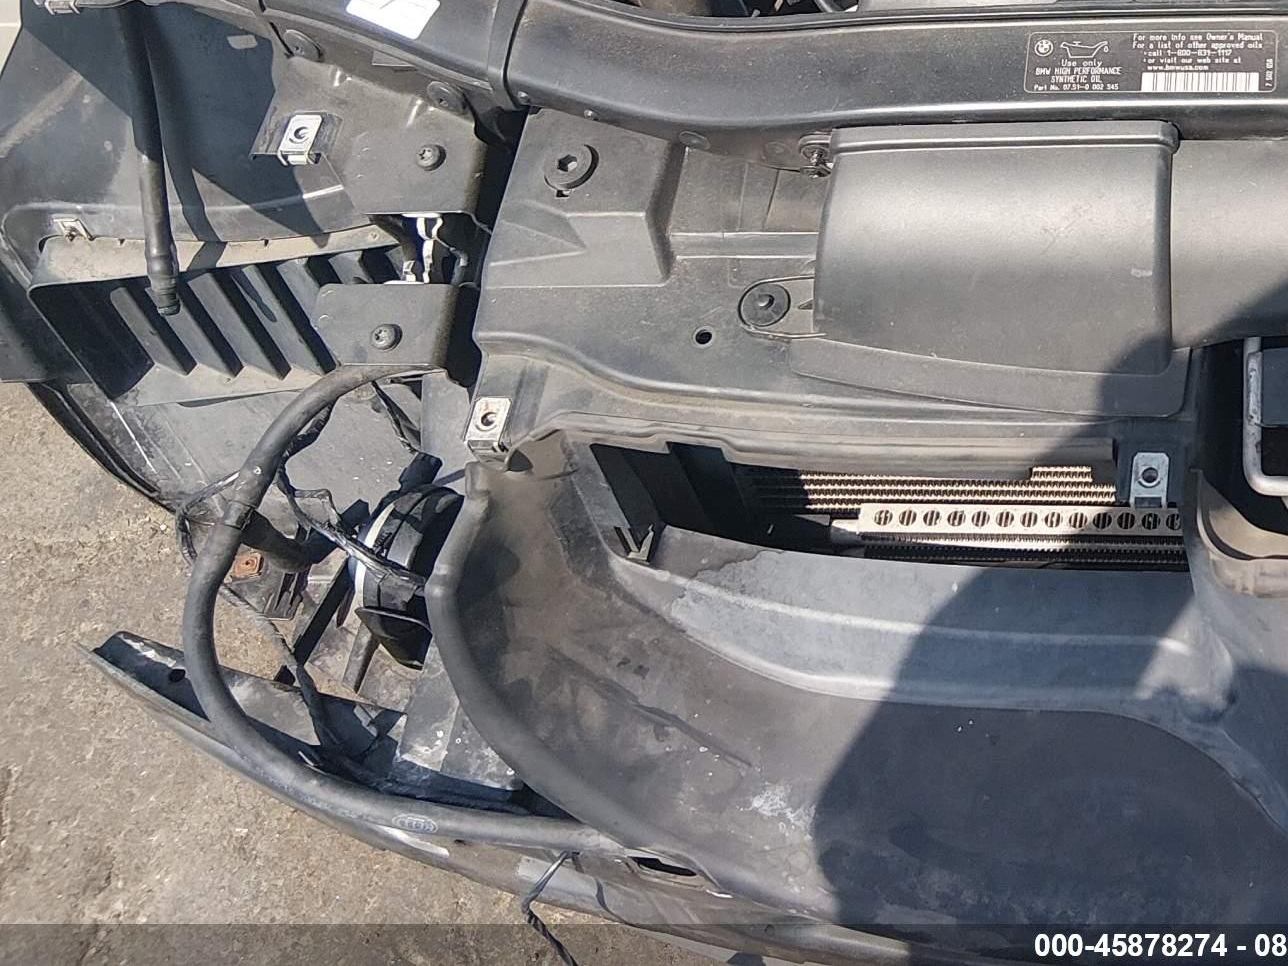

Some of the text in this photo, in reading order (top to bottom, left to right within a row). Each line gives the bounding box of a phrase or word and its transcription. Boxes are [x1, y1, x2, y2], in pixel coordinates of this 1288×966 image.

[1132, 41, 1145, 49] For
[1211, 41, 1244, 49] approved
[1083, 59, 1102, 67] only
[1091, 75, 1102, 83] OIL
